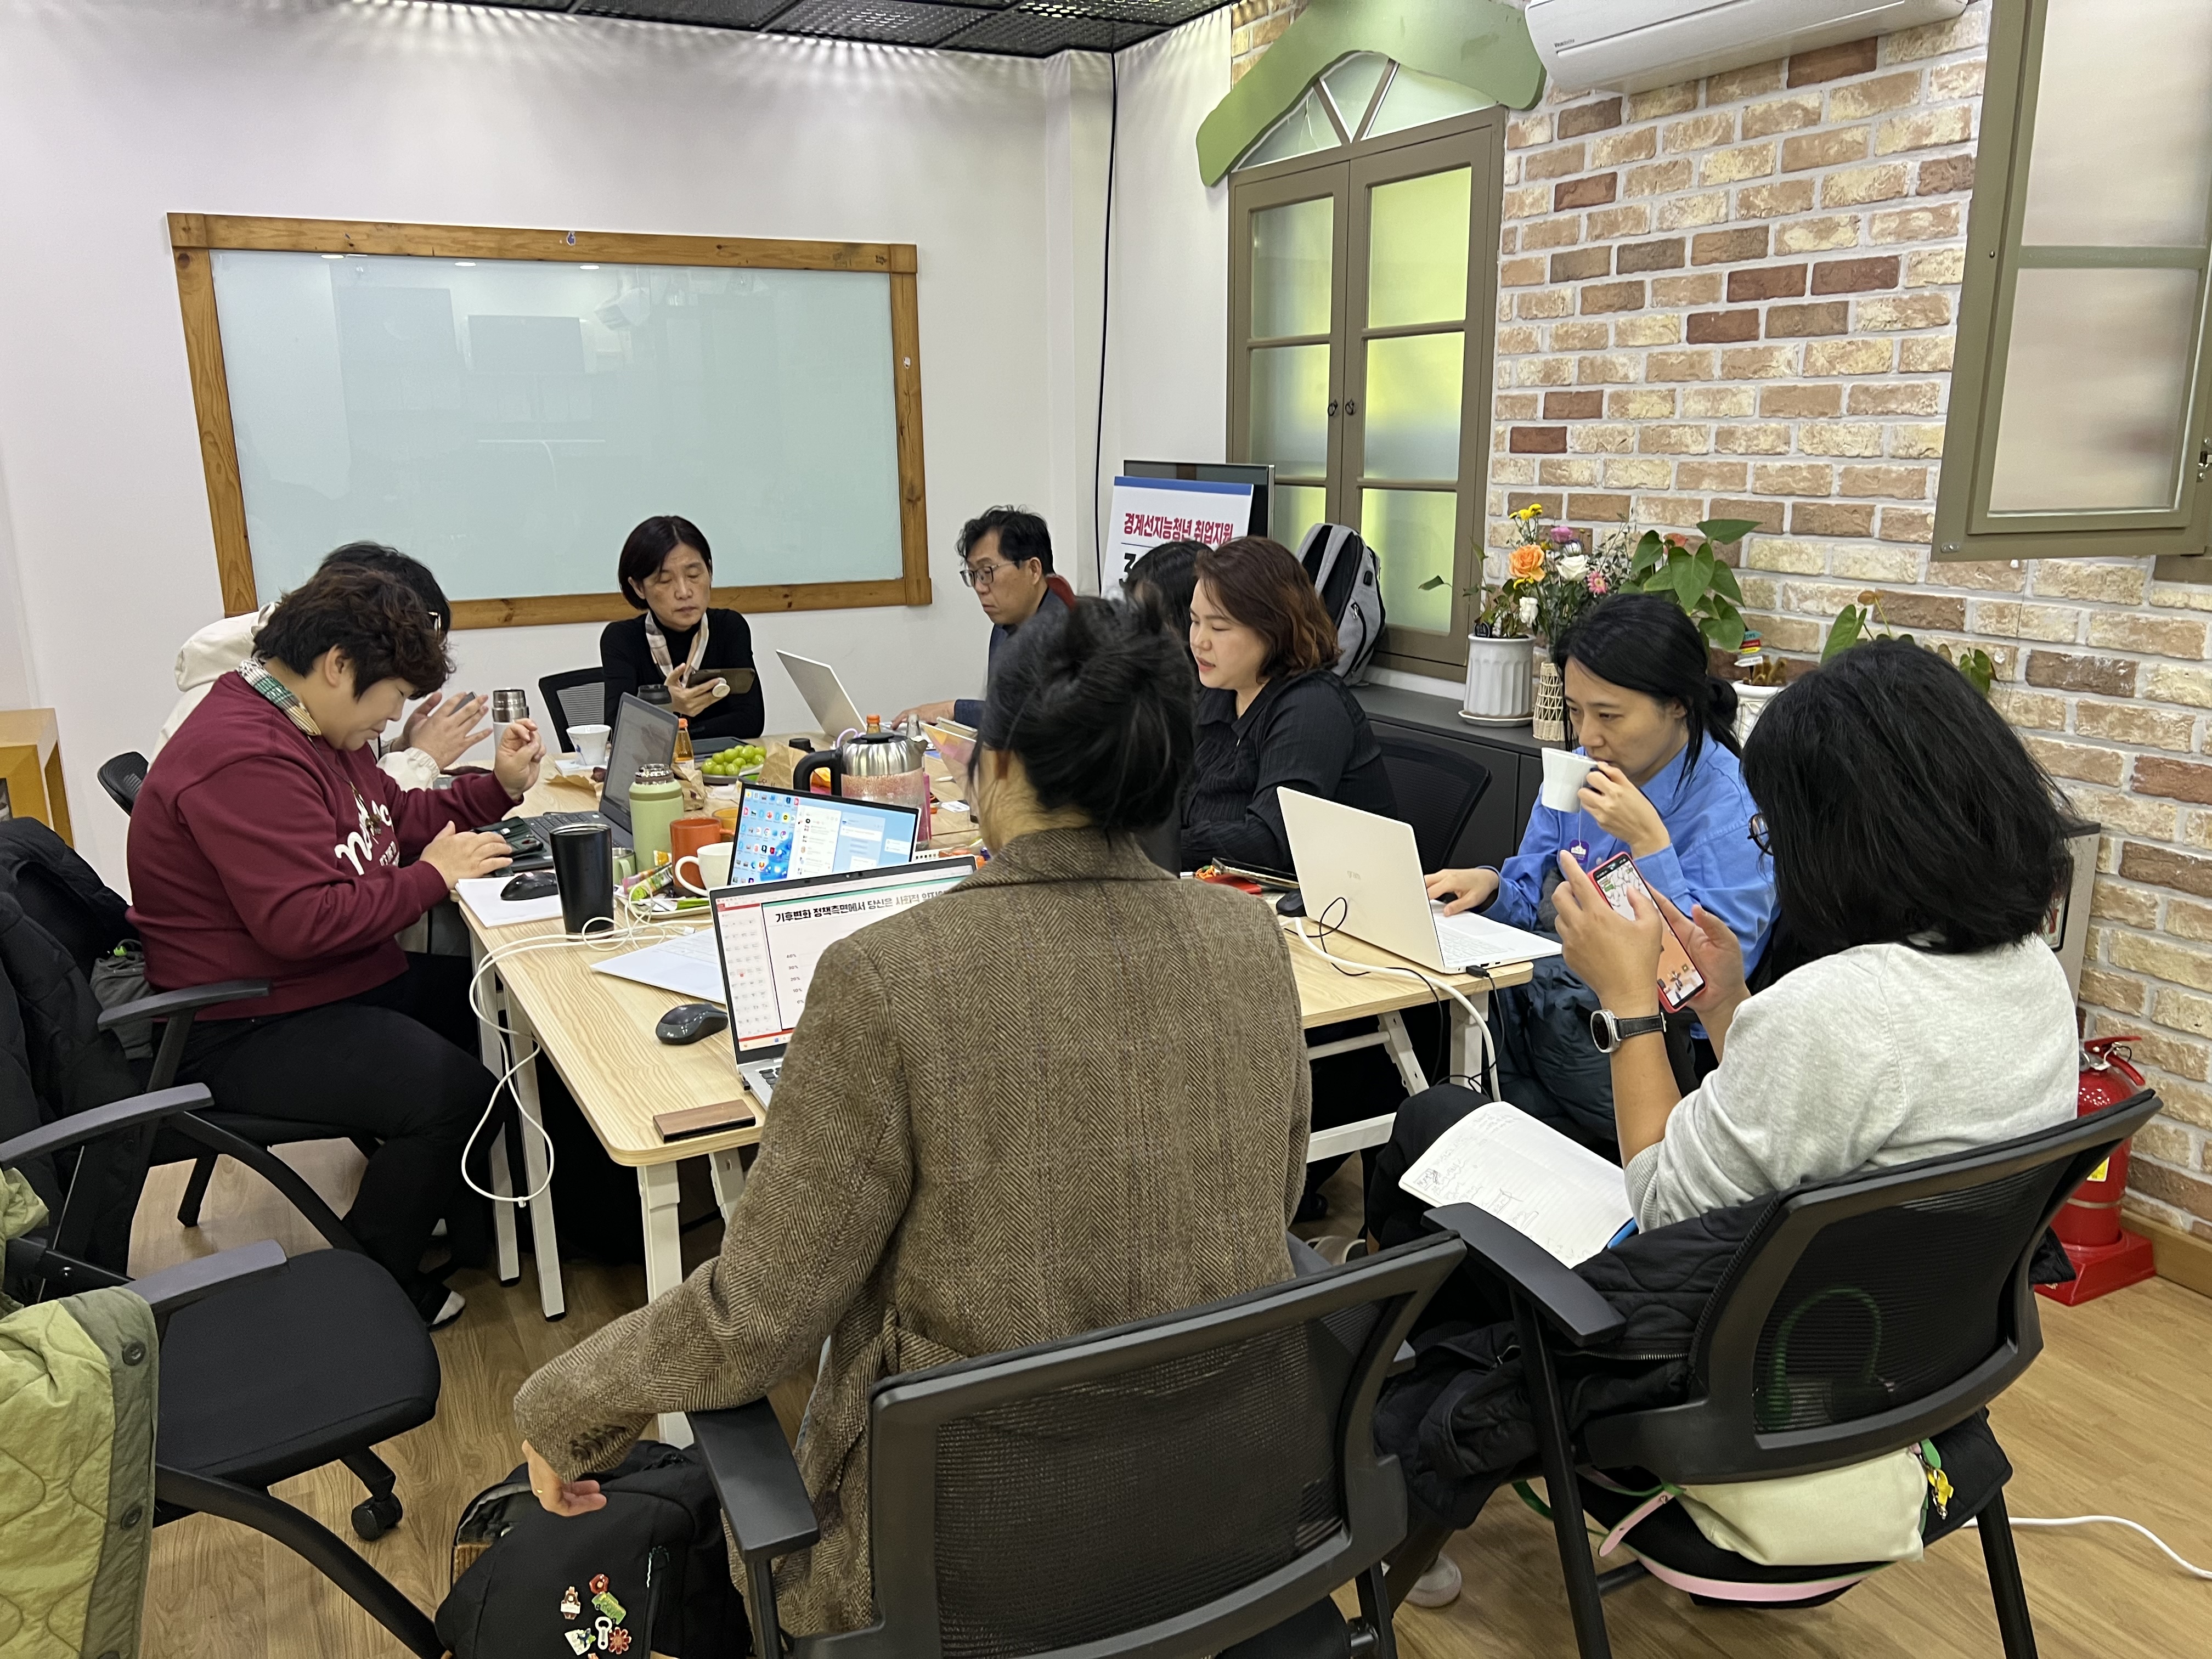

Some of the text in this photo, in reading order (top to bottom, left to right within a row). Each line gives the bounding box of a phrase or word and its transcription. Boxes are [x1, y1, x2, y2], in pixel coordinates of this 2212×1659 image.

[1125, 513, 1233, 544] 경계선지능청년 취업지원
[775, 909, 811, 923] 기후변화
[813, 901, 866, 917] 정책측면에서
